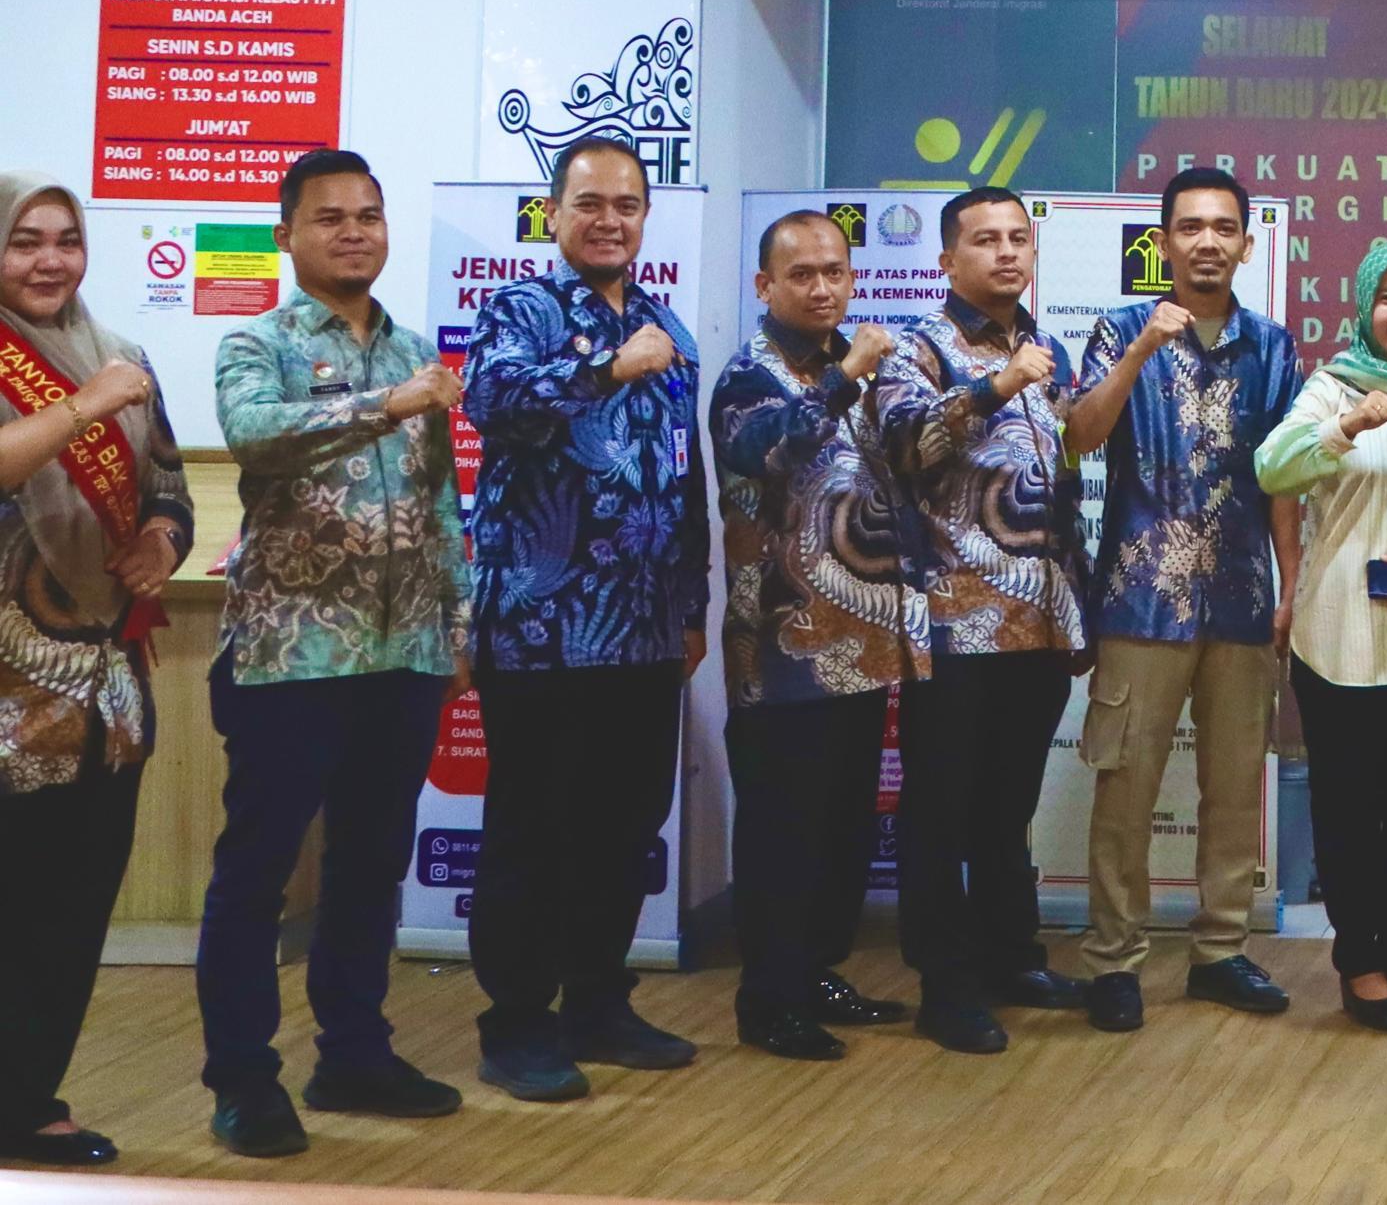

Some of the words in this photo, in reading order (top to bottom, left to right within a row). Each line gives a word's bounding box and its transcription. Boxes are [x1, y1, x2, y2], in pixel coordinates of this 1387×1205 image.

[172, 8, 227, 23] BANDA
[230, 10, 273, 24] ACEH
[1202, 14, 1331, 58] SELAMAT
[147, 40, 199, 55] SENIN
[203, 41, 234, 56] S.D
[238, 42, 295, 57] KAMIS
[107, 67, 145, 80] PAGI
[168, 68, 213, 82] 08.00
[217, 69, 239, 82] s.d
[242, 70, 283, 83] 12.00
[286, 71, 318, 84] WIB
[107, 87, 156, 101] SIANG
[171, 88, 212, 102] 13.30
[215, 89, 237, 102] s.d
[241, 90, 281, 104] 16.00
[285, 91, 316, 104] WIB
[1135, 76, 1228, 118] TAHUN
[1237, 77, 1313, 119] BARU
[185, 120, 251, 136] JUM'AT
[104, 146, 142, 160] PAGI
[165, 147, 210, 161] 08.00
[213, 149, 235, 162] s.d
[239, 150, 280, 163] 12.00
[104, 167, 153, 181] SIANG
[168, 168, 210, 182] 14.00
[213, 169, 235, 182] s.d
[239, 170, 279, 183] 16.30
[452, 257, 536, 280] JENIS
[853, 269, 871, 280] RIF
[875, 269, 908, 280] ATAS
[911, 270, 946, 280] PNBP
[149, 295, 183, 303] ROKOK
[872, 288, 951, 300] KEMENKU
[1047, 305, 1104, 316] KEMENTERIAN
[1063, 330, 1091, 339] KANTO
[8, 376, 46, 413] IMIGR
[69, 436, 93, 465] LAS
[455, 440, 482, 450] LAYA
[97, 444, 129, 491] BAK
[452, 728, 486, 739] GAND
[451, 746, 487, 757] SURAT
[1050, 739, 1073, 748] EPALA
[1152, 812, 1175, 822] NTING
[1186, 825, 1198, 835] 00
